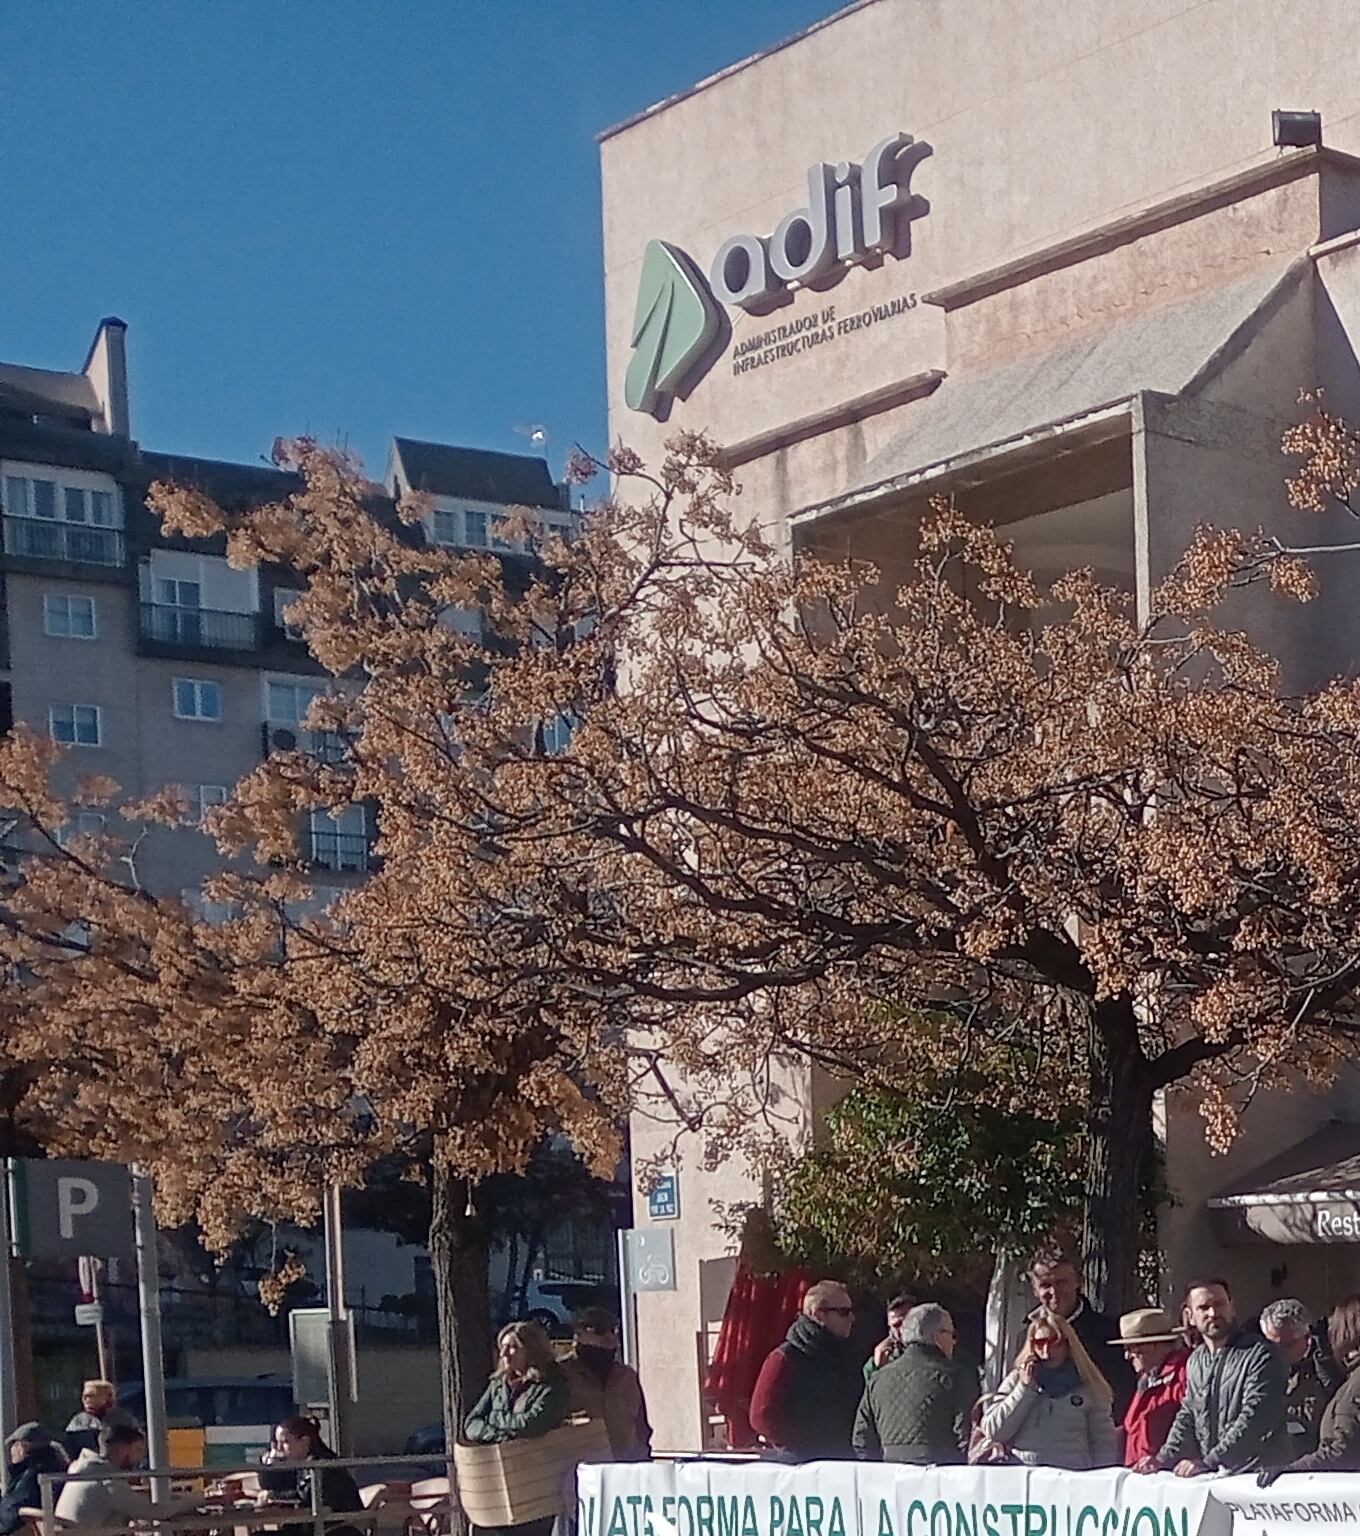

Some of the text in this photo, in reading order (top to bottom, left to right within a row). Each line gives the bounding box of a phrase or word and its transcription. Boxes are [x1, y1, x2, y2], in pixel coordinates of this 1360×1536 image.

[711, 132, 914, 305] adif
[733, 305, 836, 360] ADMINISTRADOR DE
[733, 293, 918, 376] INFRAESTRUCTURAS FERROVIARIAS
[57, 1177, 99, 1238] P
[1230, 1500, 1356, 1524] PLATAFORMA
